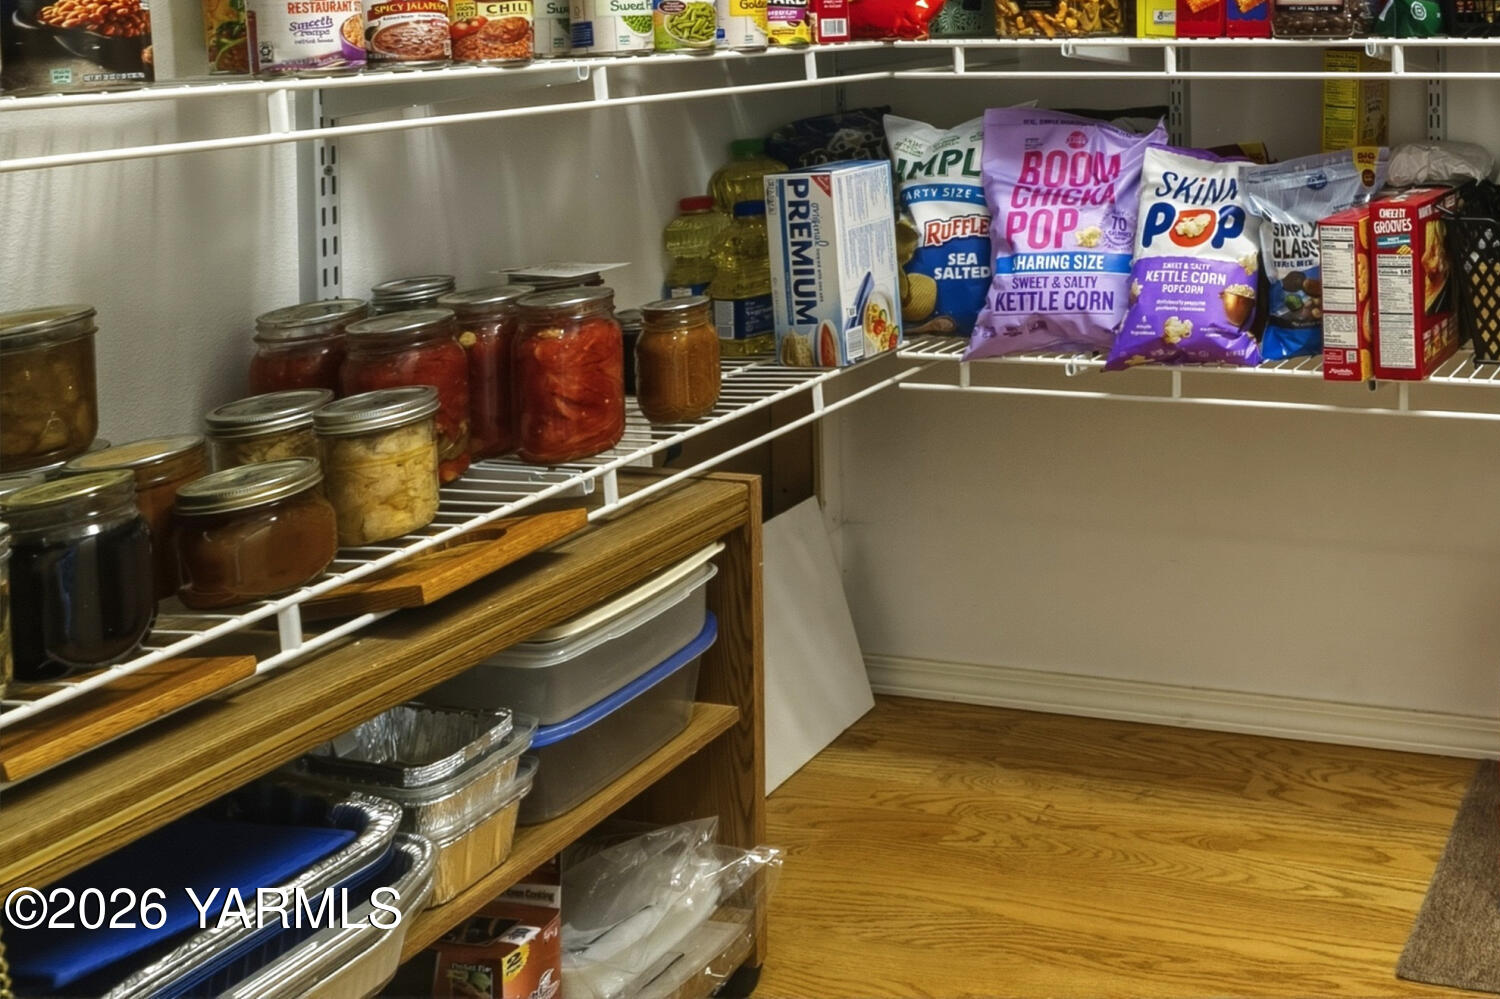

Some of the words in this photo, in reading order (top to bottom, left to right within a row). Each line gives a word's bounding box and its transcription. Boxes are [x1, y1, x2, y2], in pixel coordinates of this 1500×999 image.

[287, 0, 354, 15] RESTAURANT
[374, 2, 403, 15] SPICY
[486, 2, 528, 15] CHILI
[1019, 151, 1122, 187] BOOM
[944, 187, 971, 199] SIZE
[1010, 185, 1116, 209] CHICKA
[810, 201, 829, 248] original
[925, 214, 991, 247] RUFFLE
[1006, 208, 1080, 250] POP
[1111, 215, 1128, 232] 70
[1142, 201, 1246, 249] POP
[1272, 222, 1319, 238] SIMPLY
[1373, 219, 1412, 235] GROOVES
[787, 178, 819, 326] PREMIUM
[1272, 238, 1320, 259] CLASS
[947, 252, 978, 266] SEA
[1012, 253, 1070, 271] SHARING
[1073, 253, 1104, 269] SIZE
[933, 265, 992, 281] SALTED
[1145, 270, 1188, 284] KETTLE
[1190, 271, 1226, 285] CORN
[1011, 276, 1049, 290] SWEET
[1051, 276, 1062, 289] &
[1063, 275, 1098, 289] SALTY
[995, 291, 1059, 312] KETTLE
[1064, 290, 1114, 311] CORN
